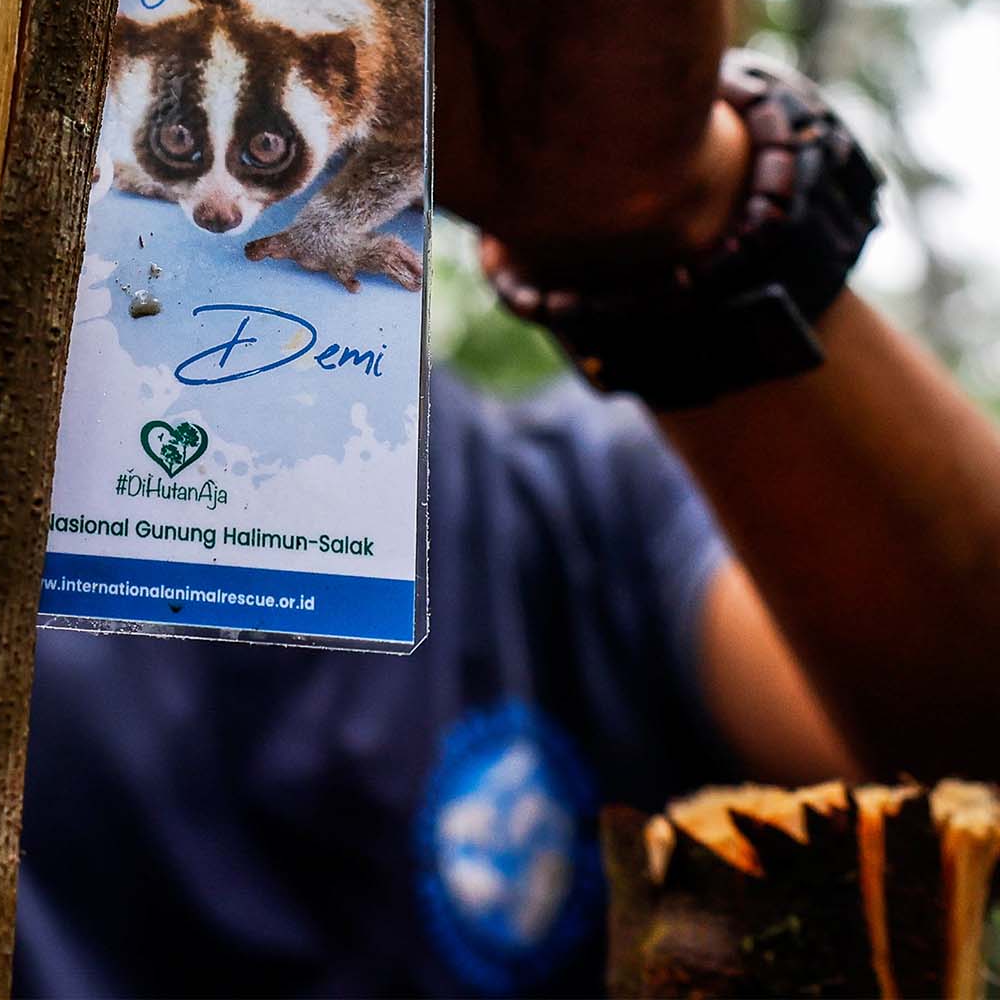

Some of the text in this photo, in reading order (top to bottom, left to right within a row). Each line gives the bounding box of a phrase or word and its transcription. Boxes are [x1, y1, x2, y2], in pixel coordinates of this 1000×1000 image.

[174, 303, 388, 386] Demi
[115, 467, 228, 511] #DiHutanAja
[135, 520, 217, 549] Gunung
[223, 527, 375, 557] Halimun-Salak
[41, 575, 316, 612] w.internationalanimalrescue.or.id
